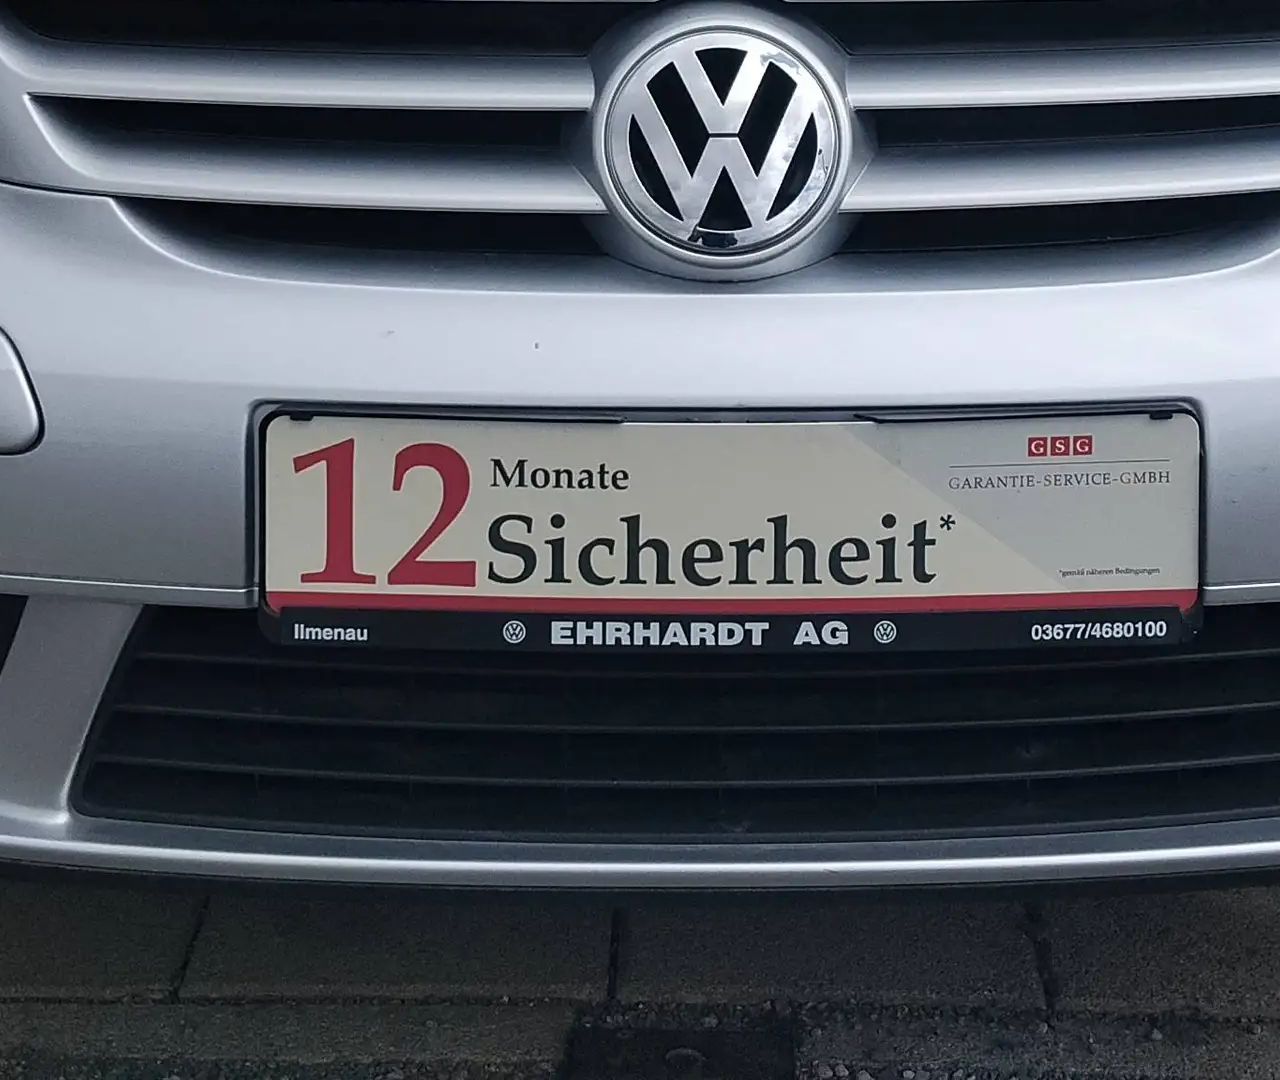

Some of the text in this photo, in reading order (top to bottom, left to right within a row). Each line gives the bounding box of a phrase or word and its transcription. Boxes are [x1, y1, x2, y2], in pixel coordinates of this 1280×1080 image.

[617, 38, 826, 238] VW
[490, 458, 630, 491] Monate
[948, 471, 1171, 490] GARANTIE-SERVICE-GMBH
[293, 437, 477, 588] 12
[294, 624, 368, 641] Ilmenau
[551, 621, 849, 646] EHRHARDT AG
[1031, 621, 1167, 641] 03677/4680100
